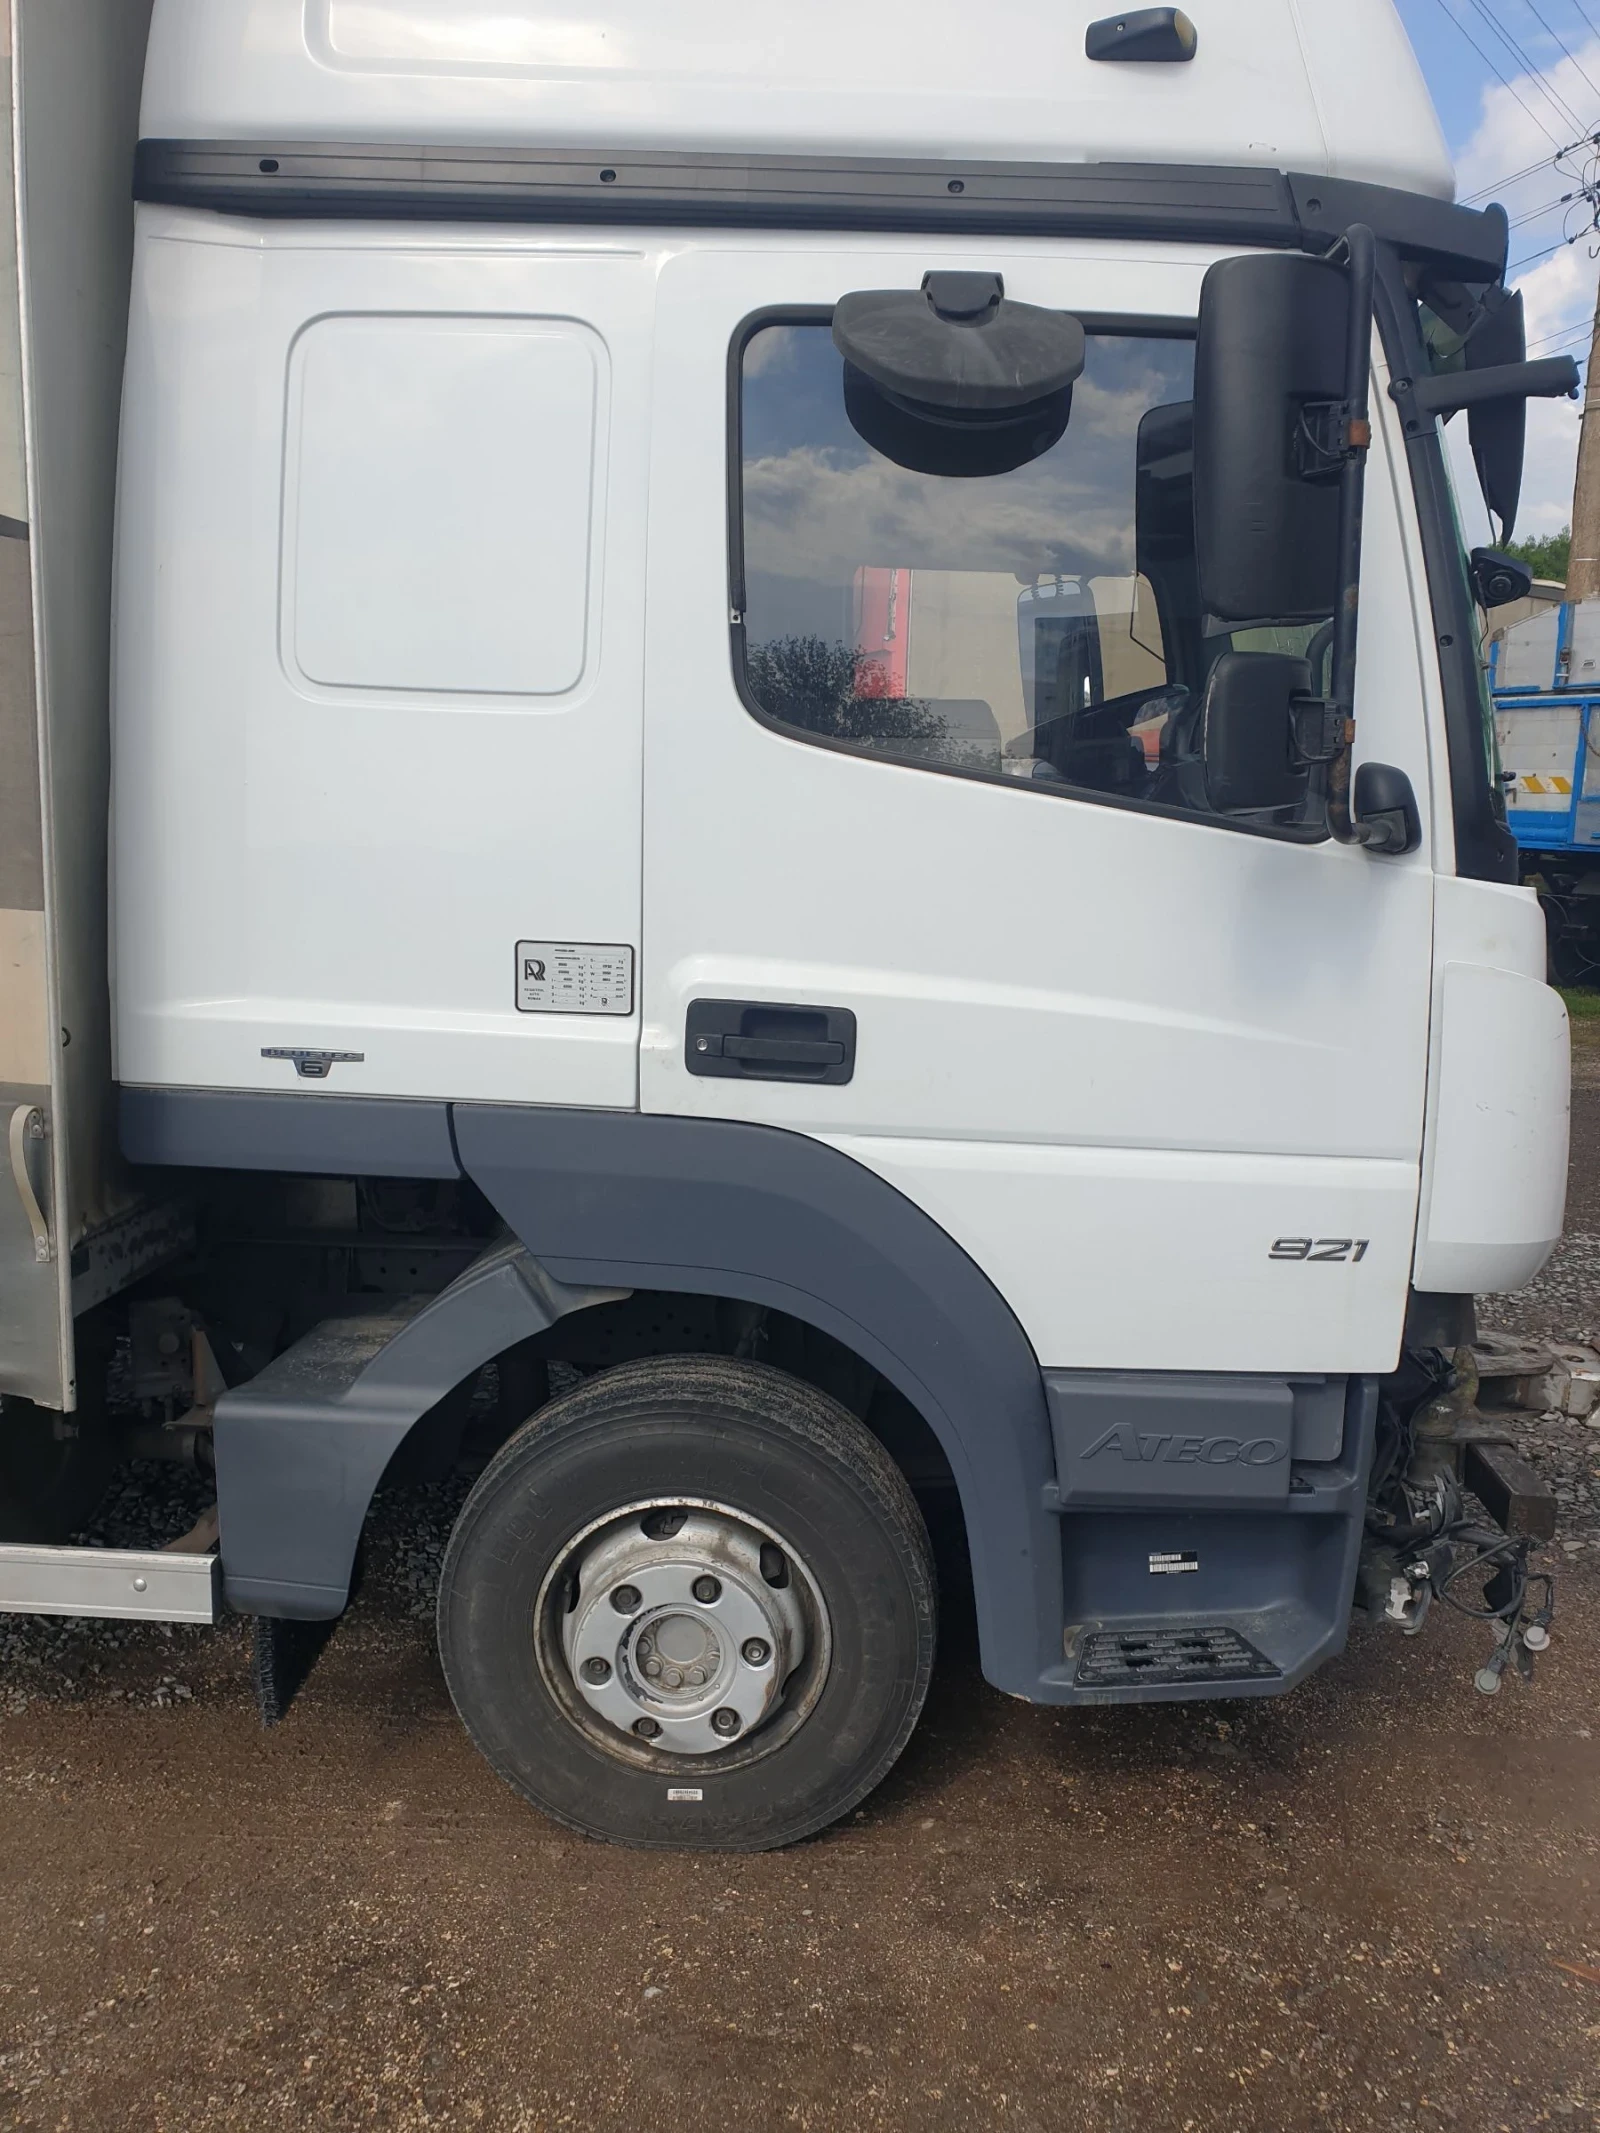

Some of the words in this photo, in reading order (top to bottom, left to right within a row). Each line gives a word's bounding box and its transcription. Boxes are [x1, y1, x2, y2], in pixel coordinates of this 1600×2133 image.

[266, 1049, 357, 1059] BLUETEC
[301, 1061, 323, 1075] 6
[1268, 1237, 1369, 1262] 921
